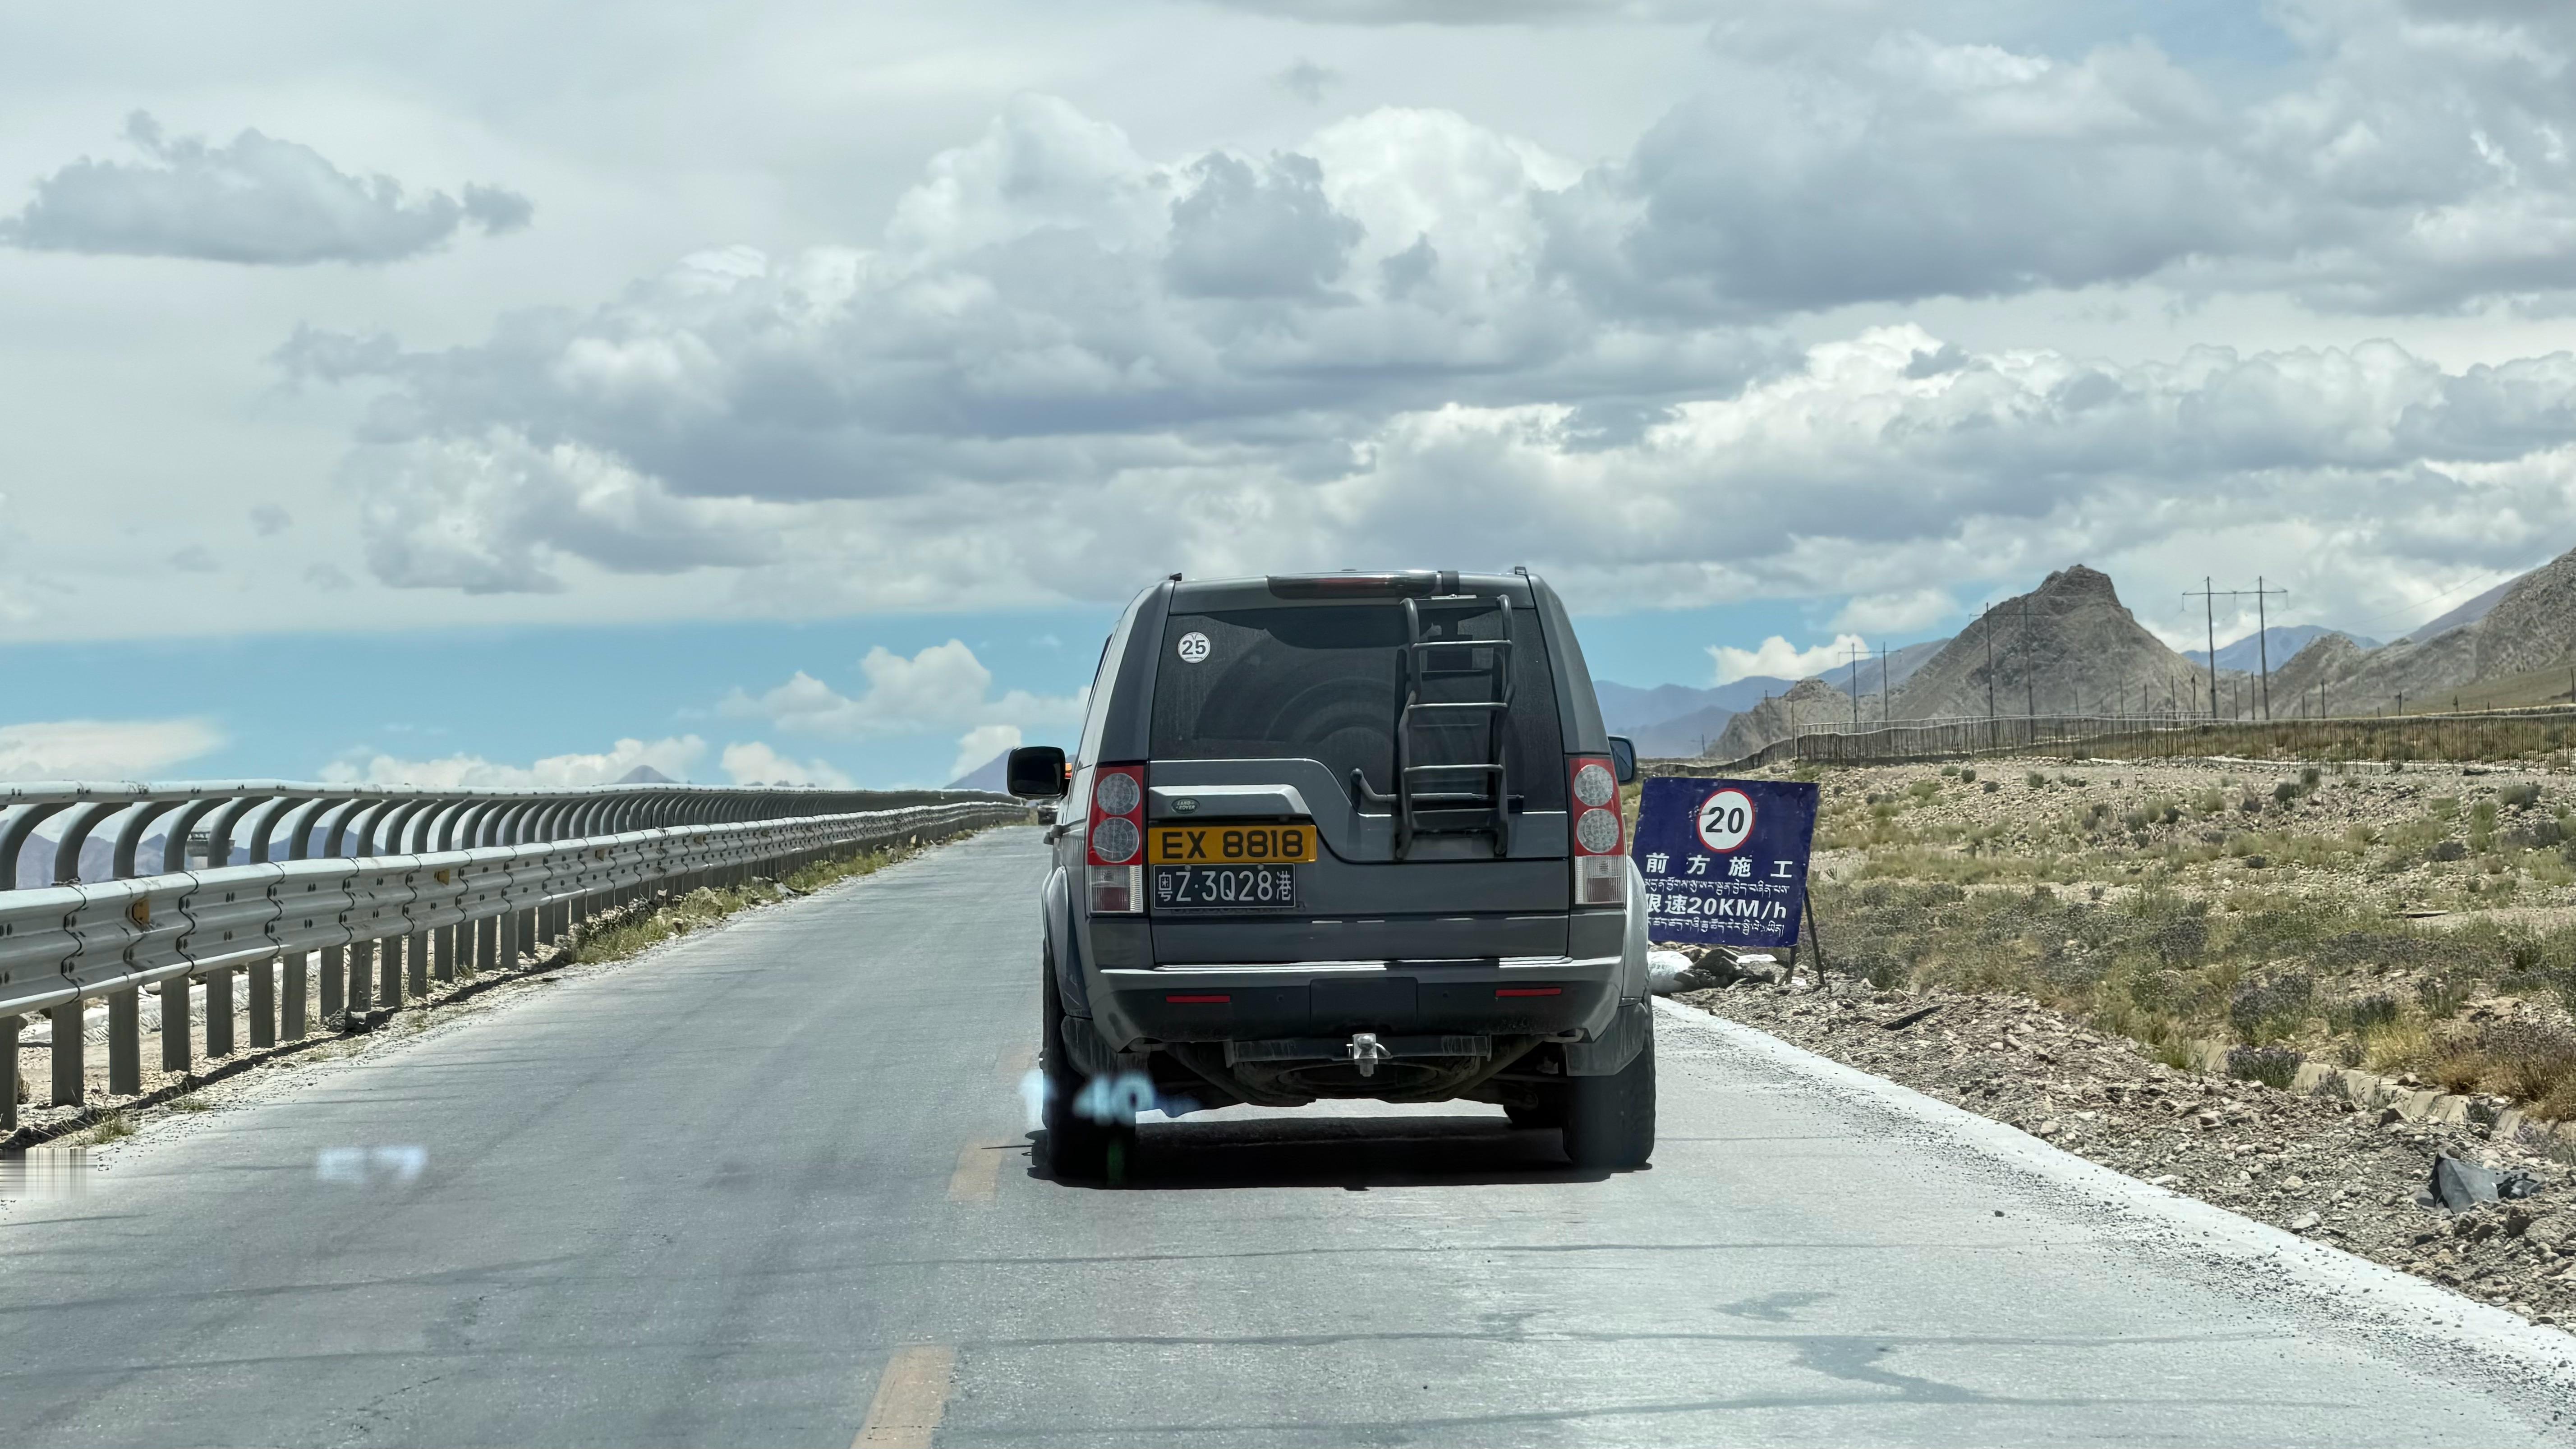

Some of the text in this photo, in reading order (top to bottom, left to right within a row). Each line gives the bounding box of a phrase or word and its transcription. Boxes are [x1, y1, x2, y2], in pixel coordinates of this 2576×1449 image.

[1182, 640, 1206, 655] 25
[1705, 806, 1745, 834] 20
[1162, 830, 1303, 859] EX 8818
[1646, 852, 1793, 878] 前方施工
